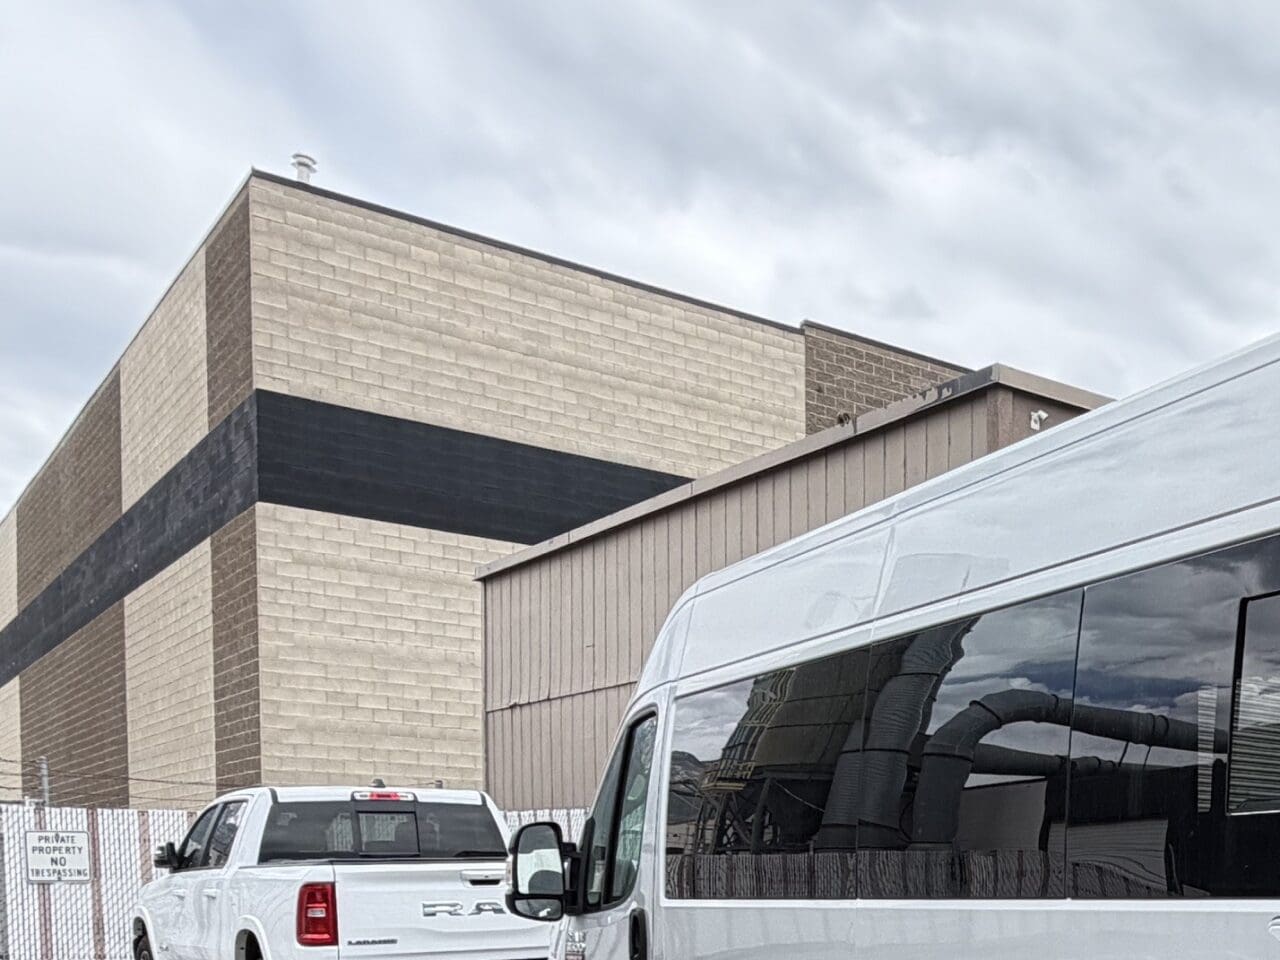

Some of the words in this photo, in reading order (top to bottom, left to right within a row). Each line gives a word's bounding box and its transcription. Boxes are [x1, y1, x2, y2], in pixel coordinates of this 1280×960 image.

[38, 835, 76, 844] PRIVATE
[32, 846, 83, 855] PROPERTY
[50, 856, 67, 867] NO
[31, 868, 88, 877] TRESPASSING
[422, 902, 507, 917] RA
